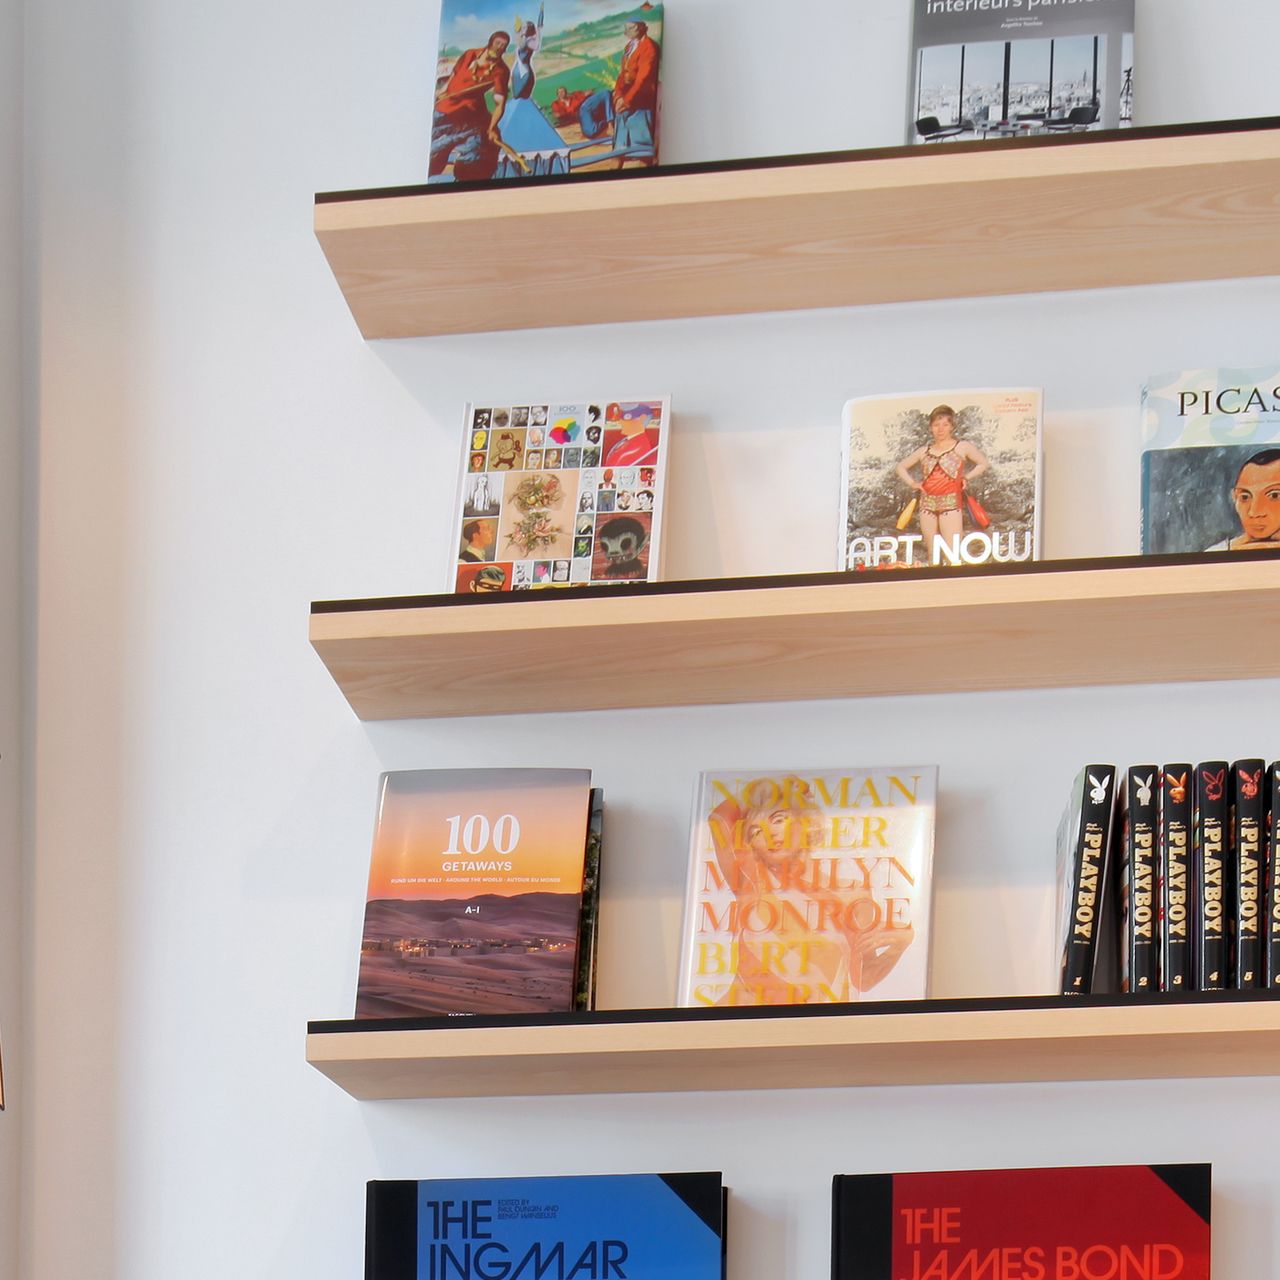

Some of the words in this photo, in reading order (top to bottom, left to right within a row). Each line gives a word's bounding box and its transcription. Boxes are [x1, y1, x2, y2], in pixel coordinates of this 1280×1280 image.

[847, 535, 923, 569] ART
[932, 531, 1032, 567] NOW
[709, 776, 922, 811] NORMAN
[441, 814, 521, 855] 100
[706, 815, 889, 851] MAILER
[441, 861, 513, 872] GETAWAYS
[703, 856, 916, 892] MARILYN
[1135, 832, 1153, 939] PLAYBOY
[1169, 832, 1187, 938] PLAYBOY
[1204, 826, 1222, 933] PLAYBOY
[1240, 826, 1259, 934] PLAYBOY
[1074, 833, 1103, 939] PLAYBOY
[698, 897, 913, 933] MONROE
[695, 940, 822, 977] BERT
[427, 1200, 492, 1239] THE
[900, 1207, 961, 1244] THE
